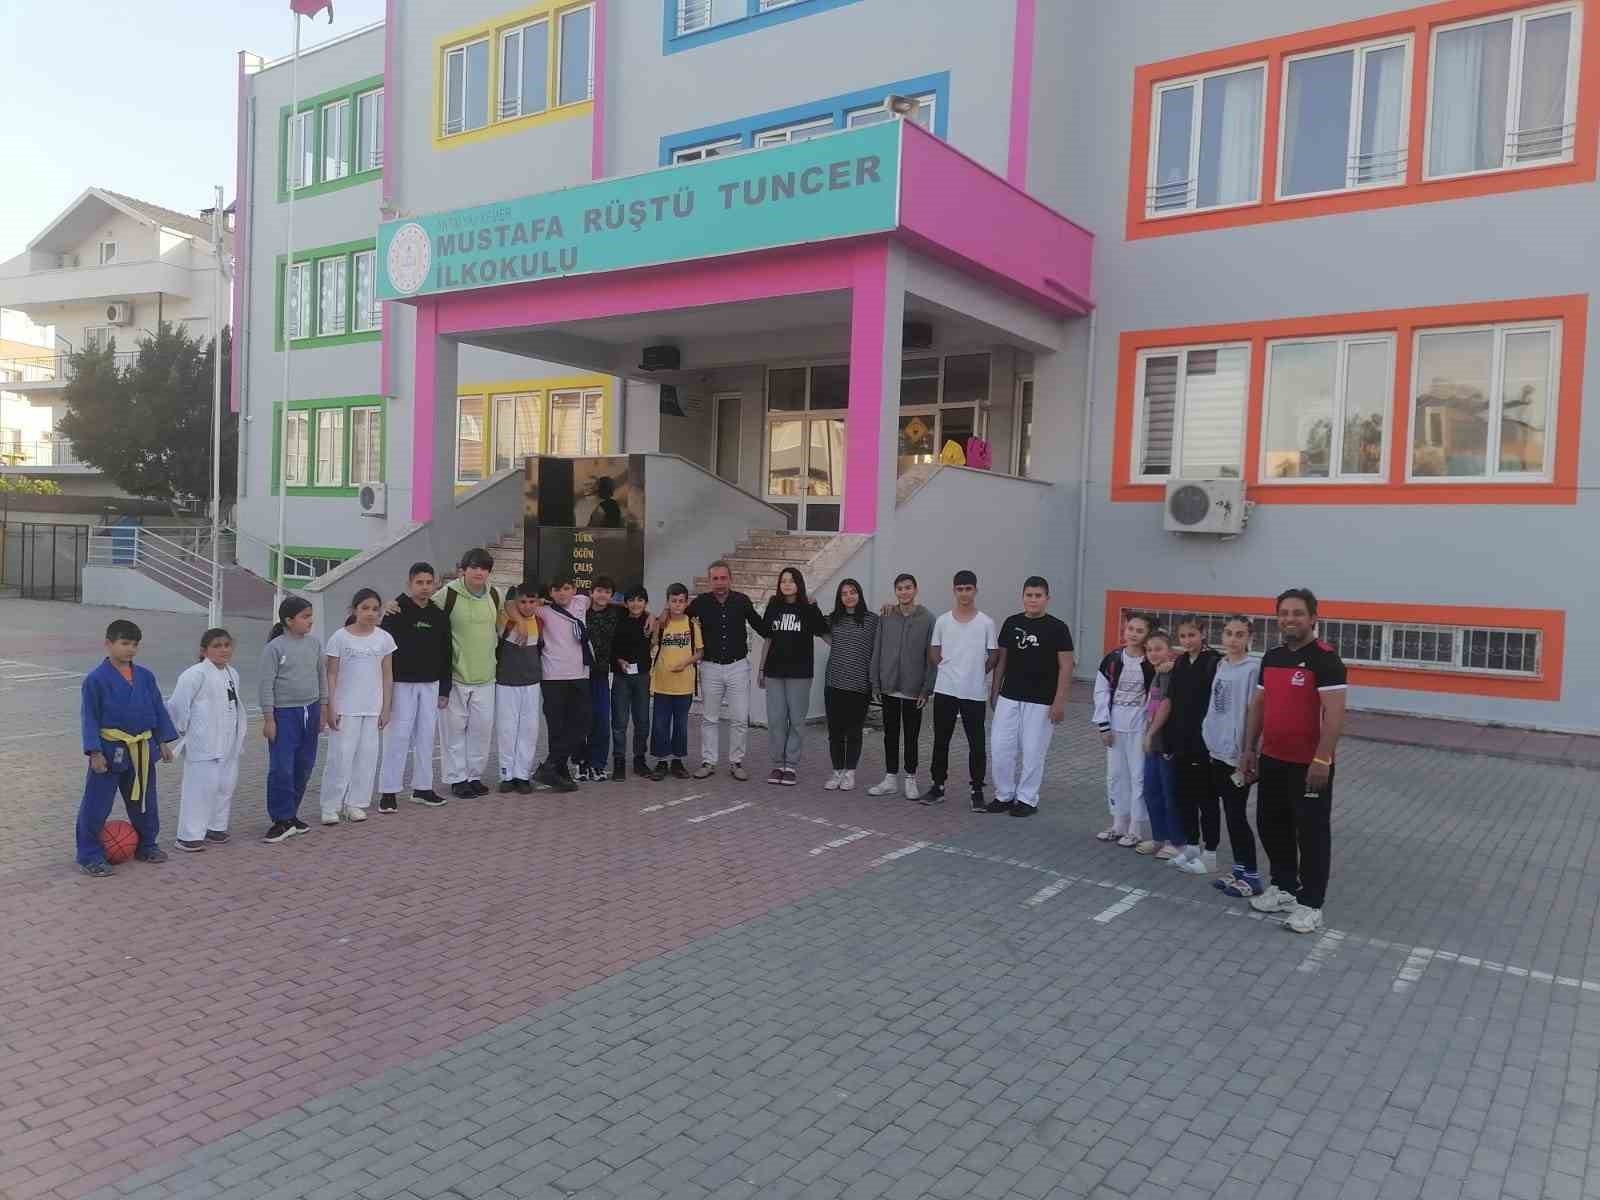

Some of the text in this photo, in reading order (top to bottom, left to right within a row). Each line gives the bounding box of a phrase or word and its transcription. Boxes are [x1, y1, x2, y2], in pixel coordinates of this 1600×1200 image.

[437, 215, 563, 257] MUSTAFA
[583, 186, 695, 233] RÜŞTÜ
[718, 154, 881, 210] TUNCER
[436, 246, 578, 288] İLKOKULU
